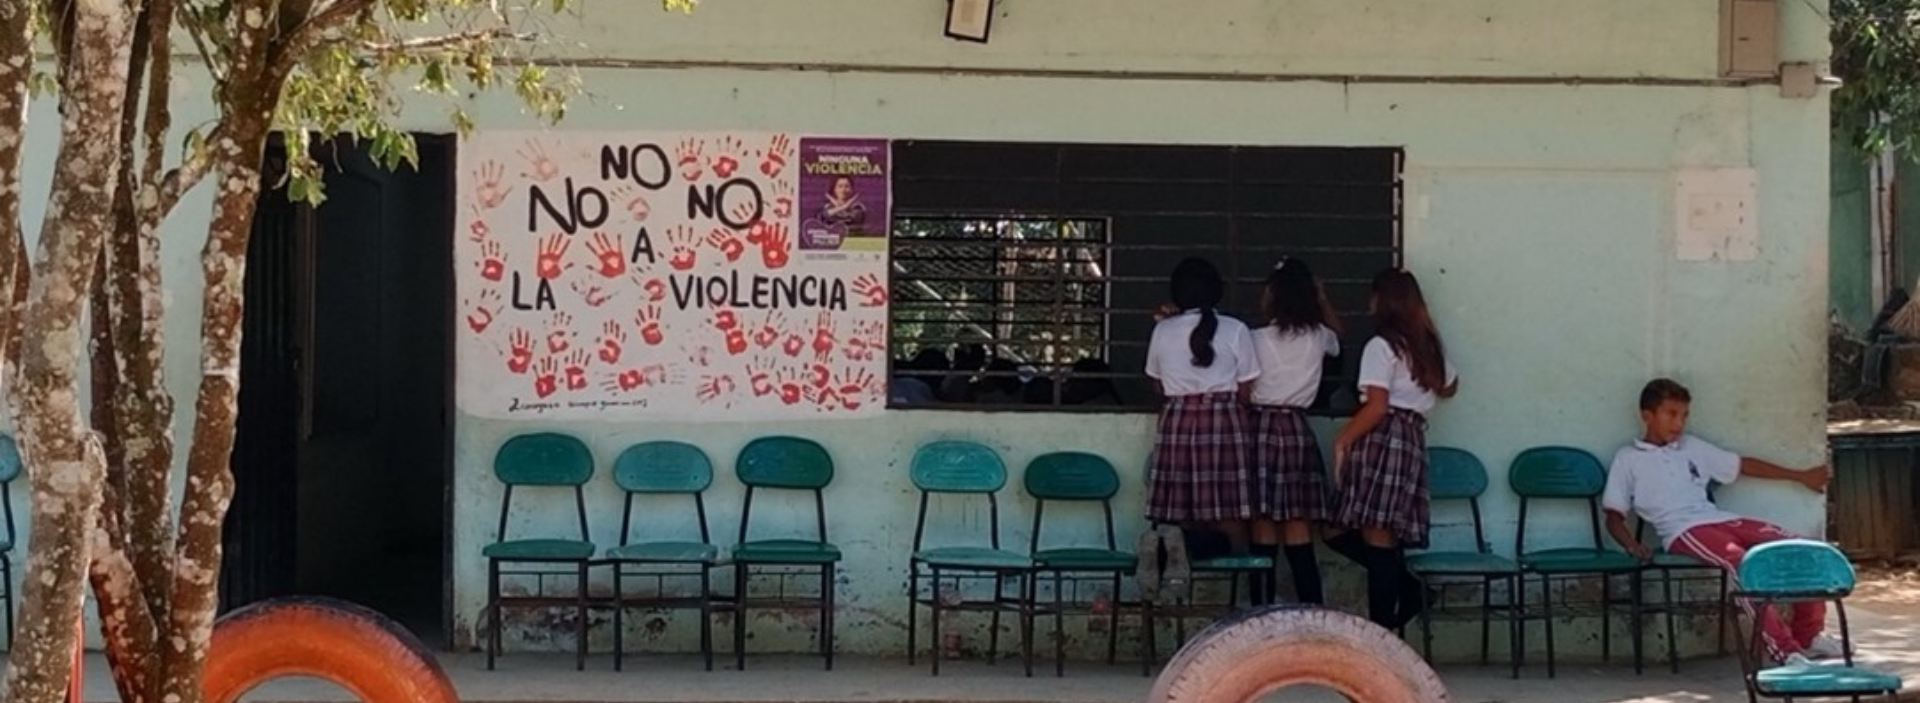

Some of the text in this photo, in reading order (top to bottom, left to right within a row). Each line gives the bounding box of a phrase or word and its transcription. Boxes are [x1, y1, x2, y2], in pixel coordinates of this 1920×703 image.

[602, 144, 671, 190] NO
[805, 163, 882, 175] VIOLENCIA
[688, 179, 762, 231] NO
[631, 227, 655, 264] A
[512, 270, 847, 311] LA VIOLENCIA
